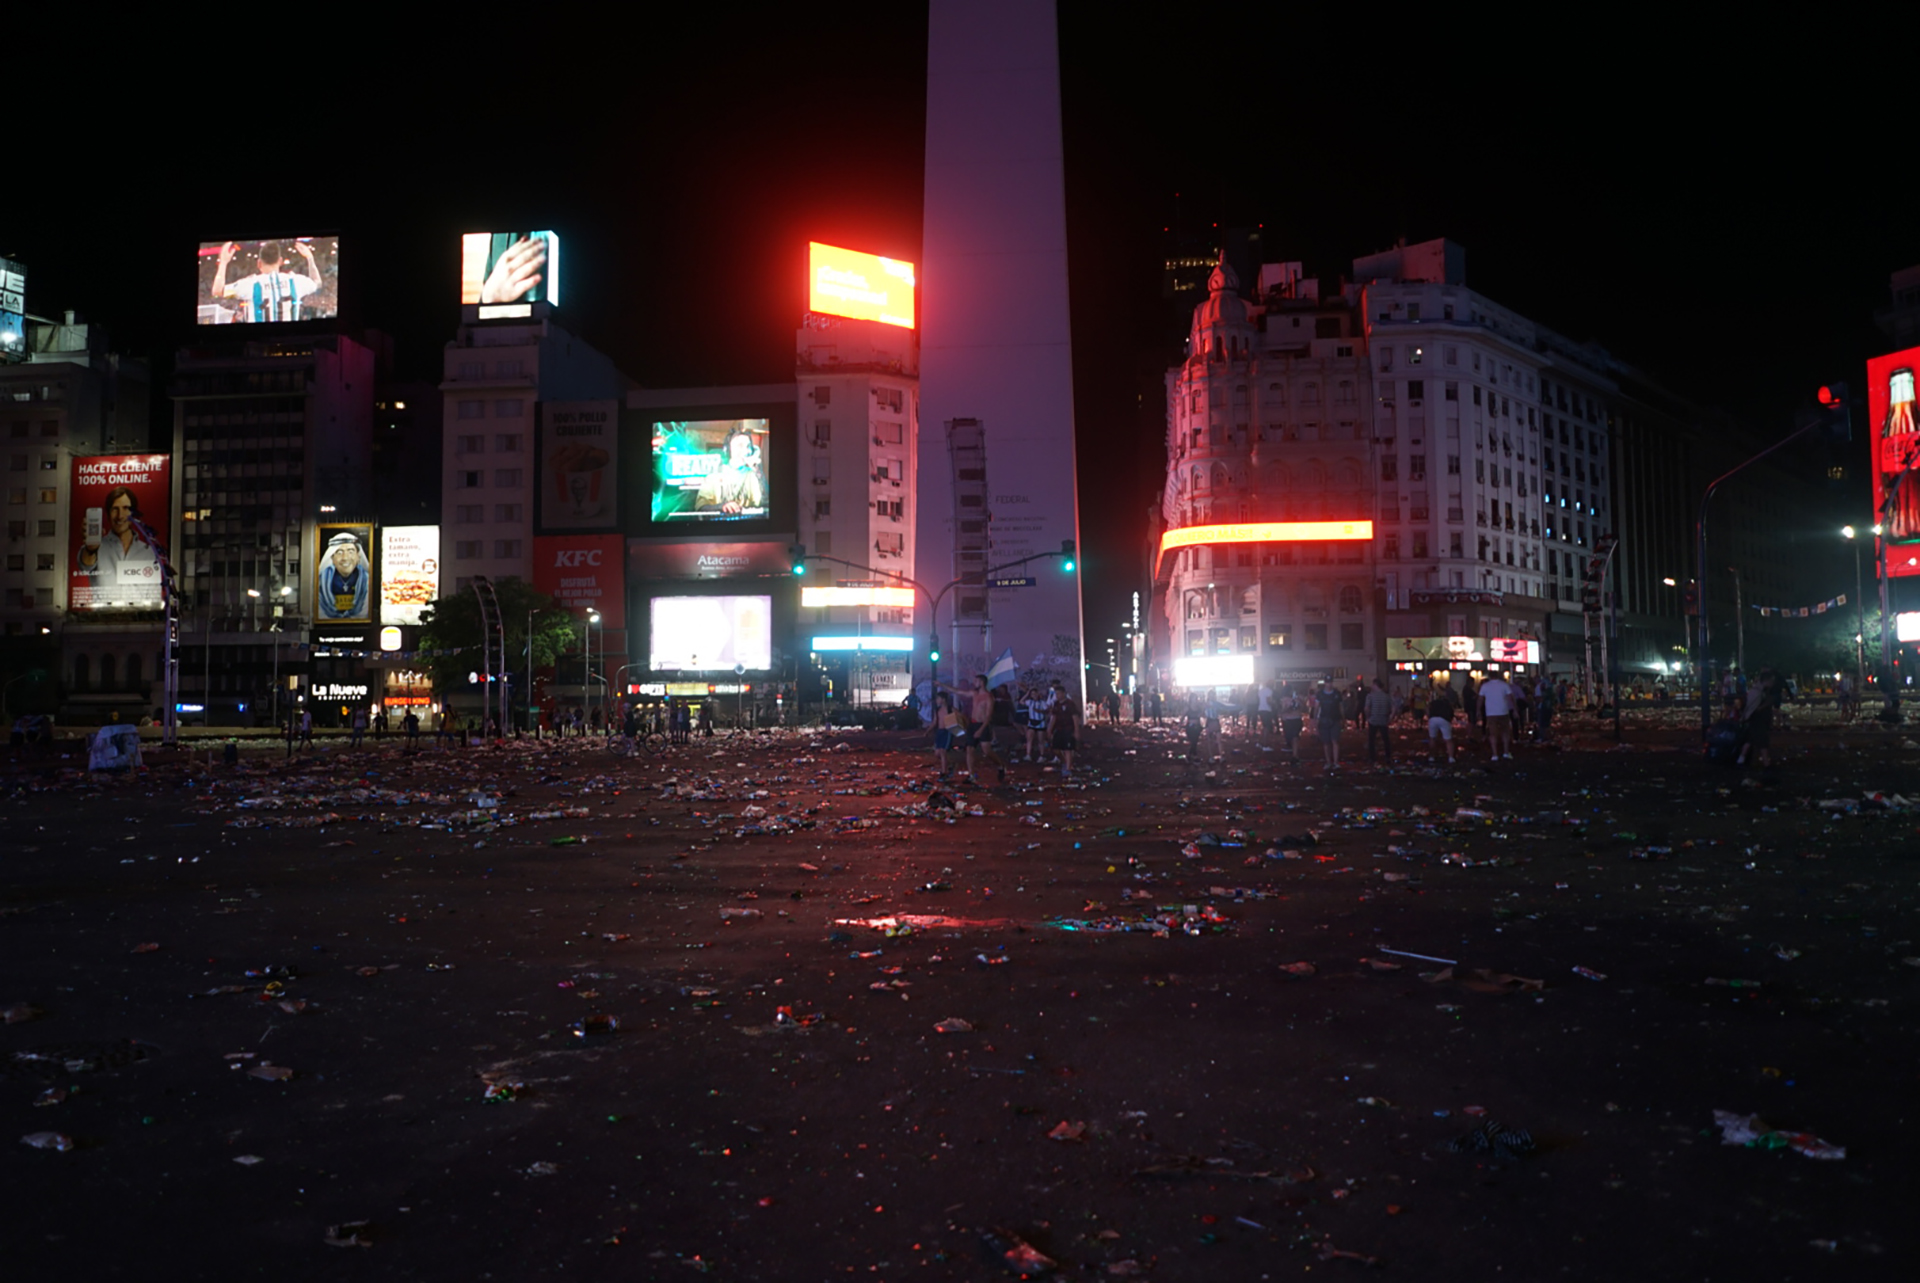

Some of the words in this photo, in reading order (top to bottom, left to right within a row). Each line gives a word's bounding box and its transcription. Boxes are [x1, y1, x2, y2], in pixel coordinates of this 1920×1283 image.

[553, 412, 577, 423] 100%
[578, 411, 608, 422] POLLO
[556, 425, 603, 436] CRUJIENTE
[79, 463, 118, 474] HACETE
[119, 461, 162, 473] CLIENTE
[78, 475, 107, 485] 100%
[108, 473, 152, 484] ONLINE.
[995, 495, 1031, 504] FEDERAL
[1173, 530, 1215, 544] QUIERO
[554, 549, 603, 567] KFC
[697, 555, 749, 565] Atacama
[123, 568, 142, 576] ICBC
[560, 575, 597, 588] DISFRUTÁ
[312, 683, 328, 696] La
[411, 696, 431, 705] KING
